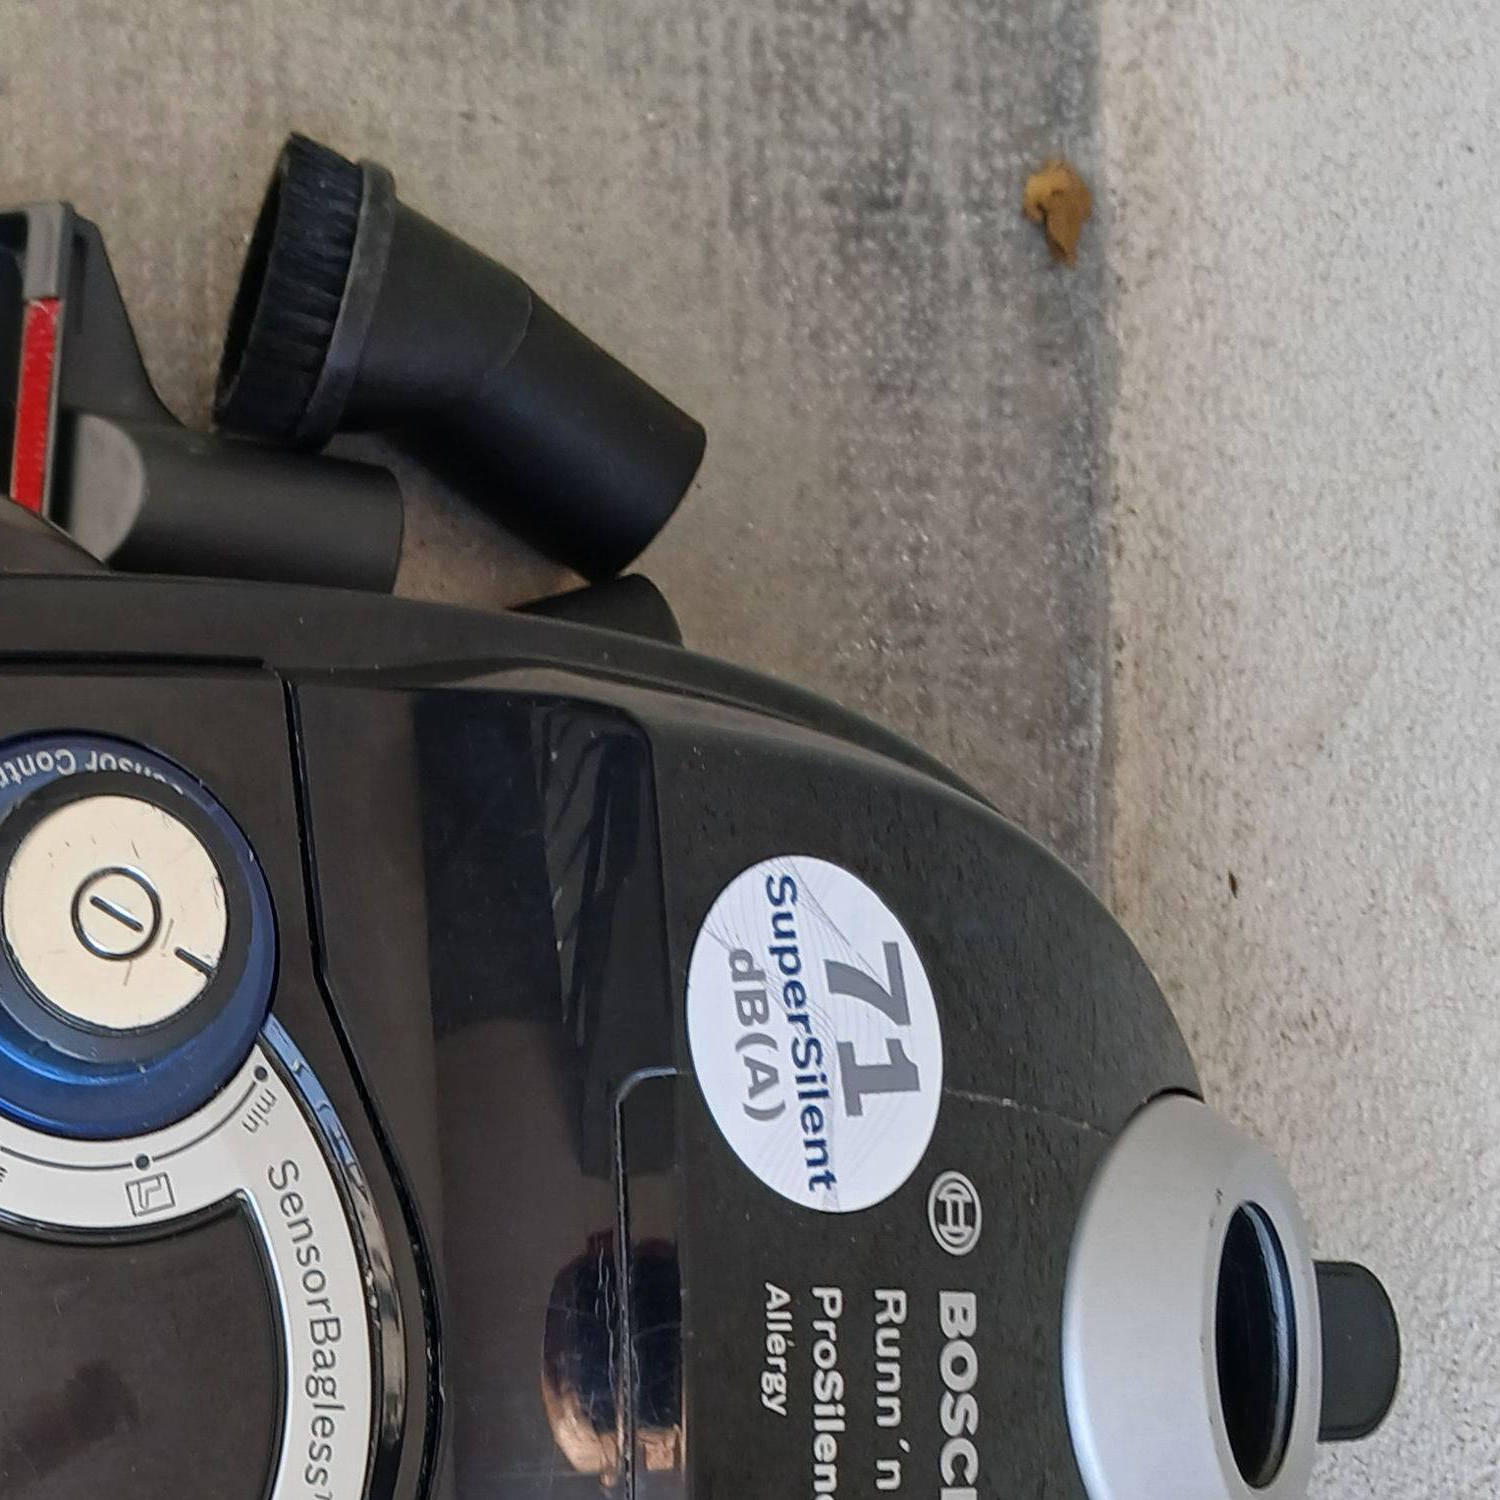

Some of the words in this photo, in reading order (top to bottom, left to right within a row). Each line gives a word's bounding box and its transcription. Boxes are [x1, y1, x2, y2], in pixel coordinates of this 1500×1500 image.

[241, 1088, 278, 1135] min
[728, 948, 786, 1122] dB(A)
[765, 874, 838, 1192] SuperSilent
[823, 940, 921, 1117] 71
